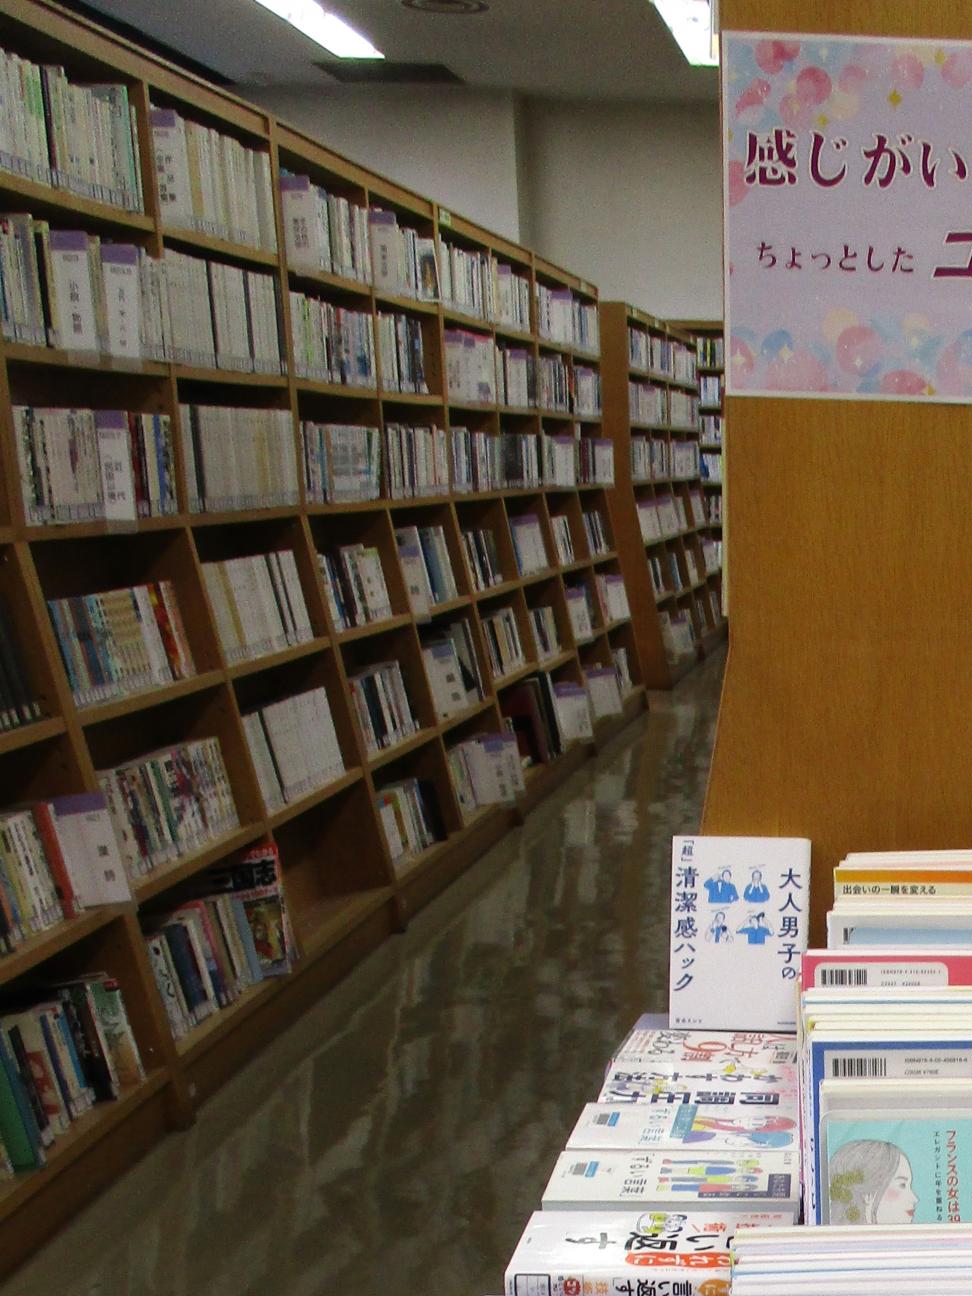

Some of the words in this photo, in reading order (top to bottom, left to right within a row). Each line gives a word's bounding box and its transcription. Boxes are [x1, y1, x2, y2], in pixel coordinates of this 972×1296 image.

[674, 839, 700, 992] 「超」清潔感ハック
[777, 867, 803, 981] 大人男子の
[842, 884, 937, 896] 出会いの一瞬を変える
